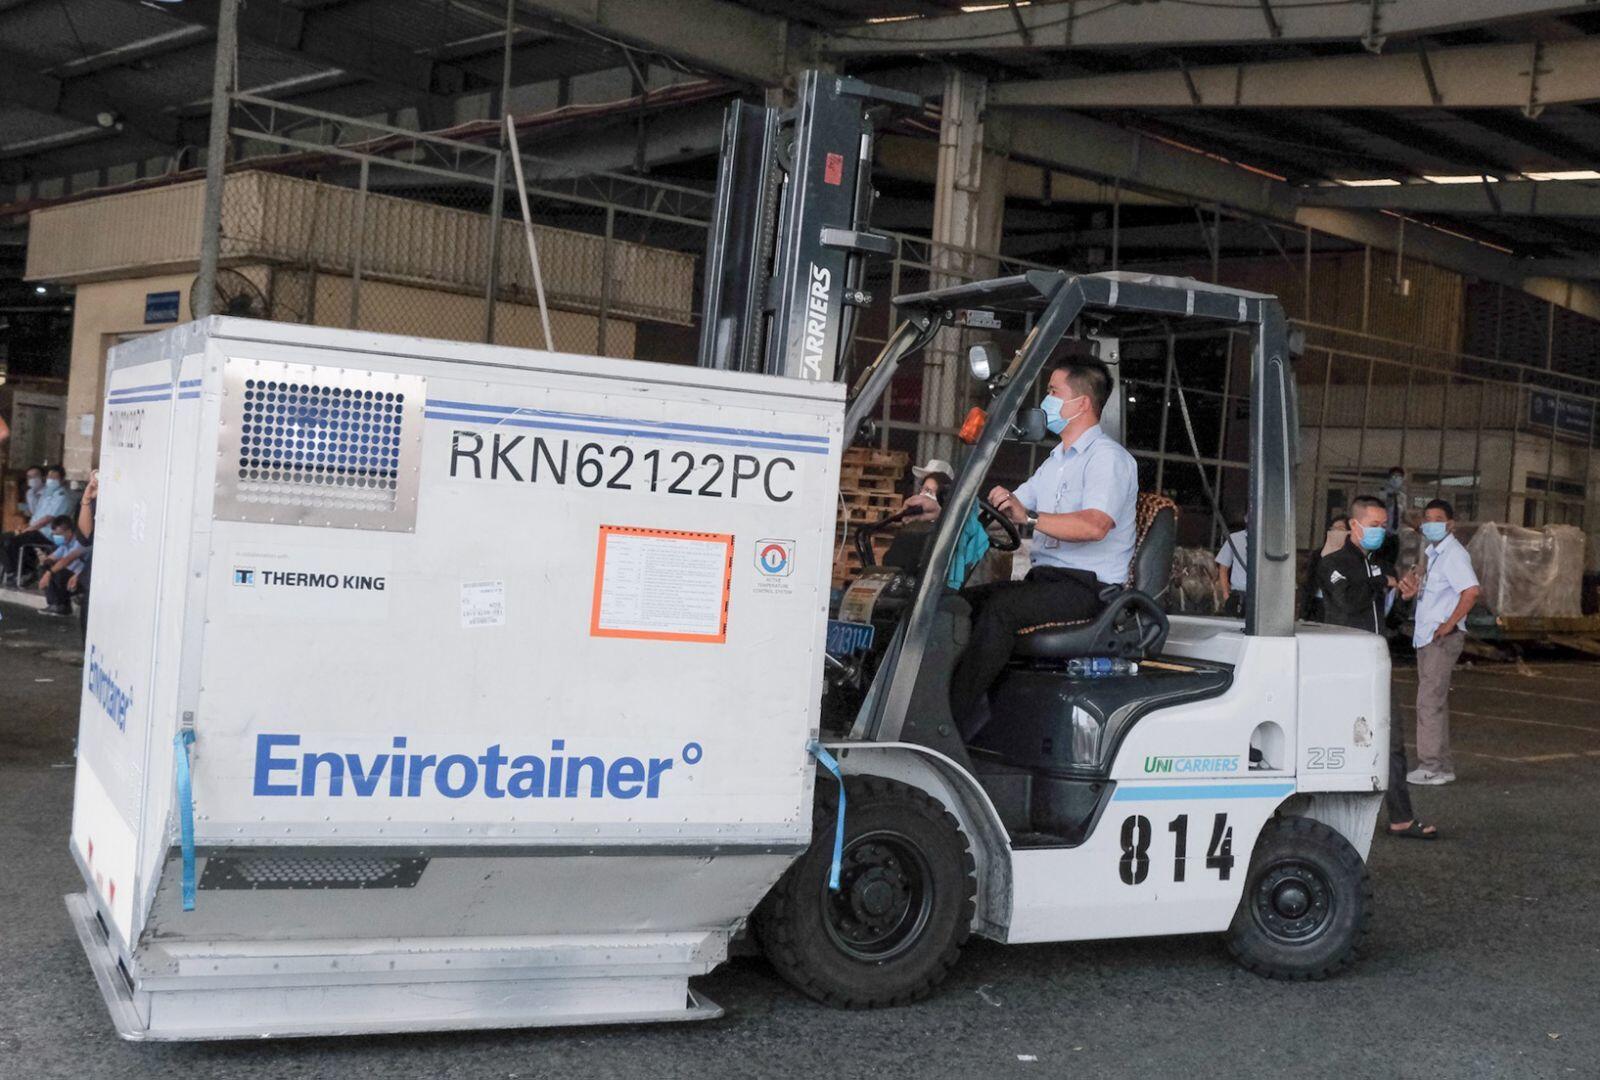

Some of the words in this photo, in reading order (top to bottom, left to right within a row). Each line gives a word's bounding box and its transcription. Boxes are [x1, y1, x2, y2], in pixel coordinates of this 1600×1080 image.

[449, 429, 796, 503] RKN62122PC
[261, 570, 339, 589] THERMO
[342, 574, 385, 591] KING
[1307, 746, 1346, 770] 25
[1118, 812, 1235, 886] 814
